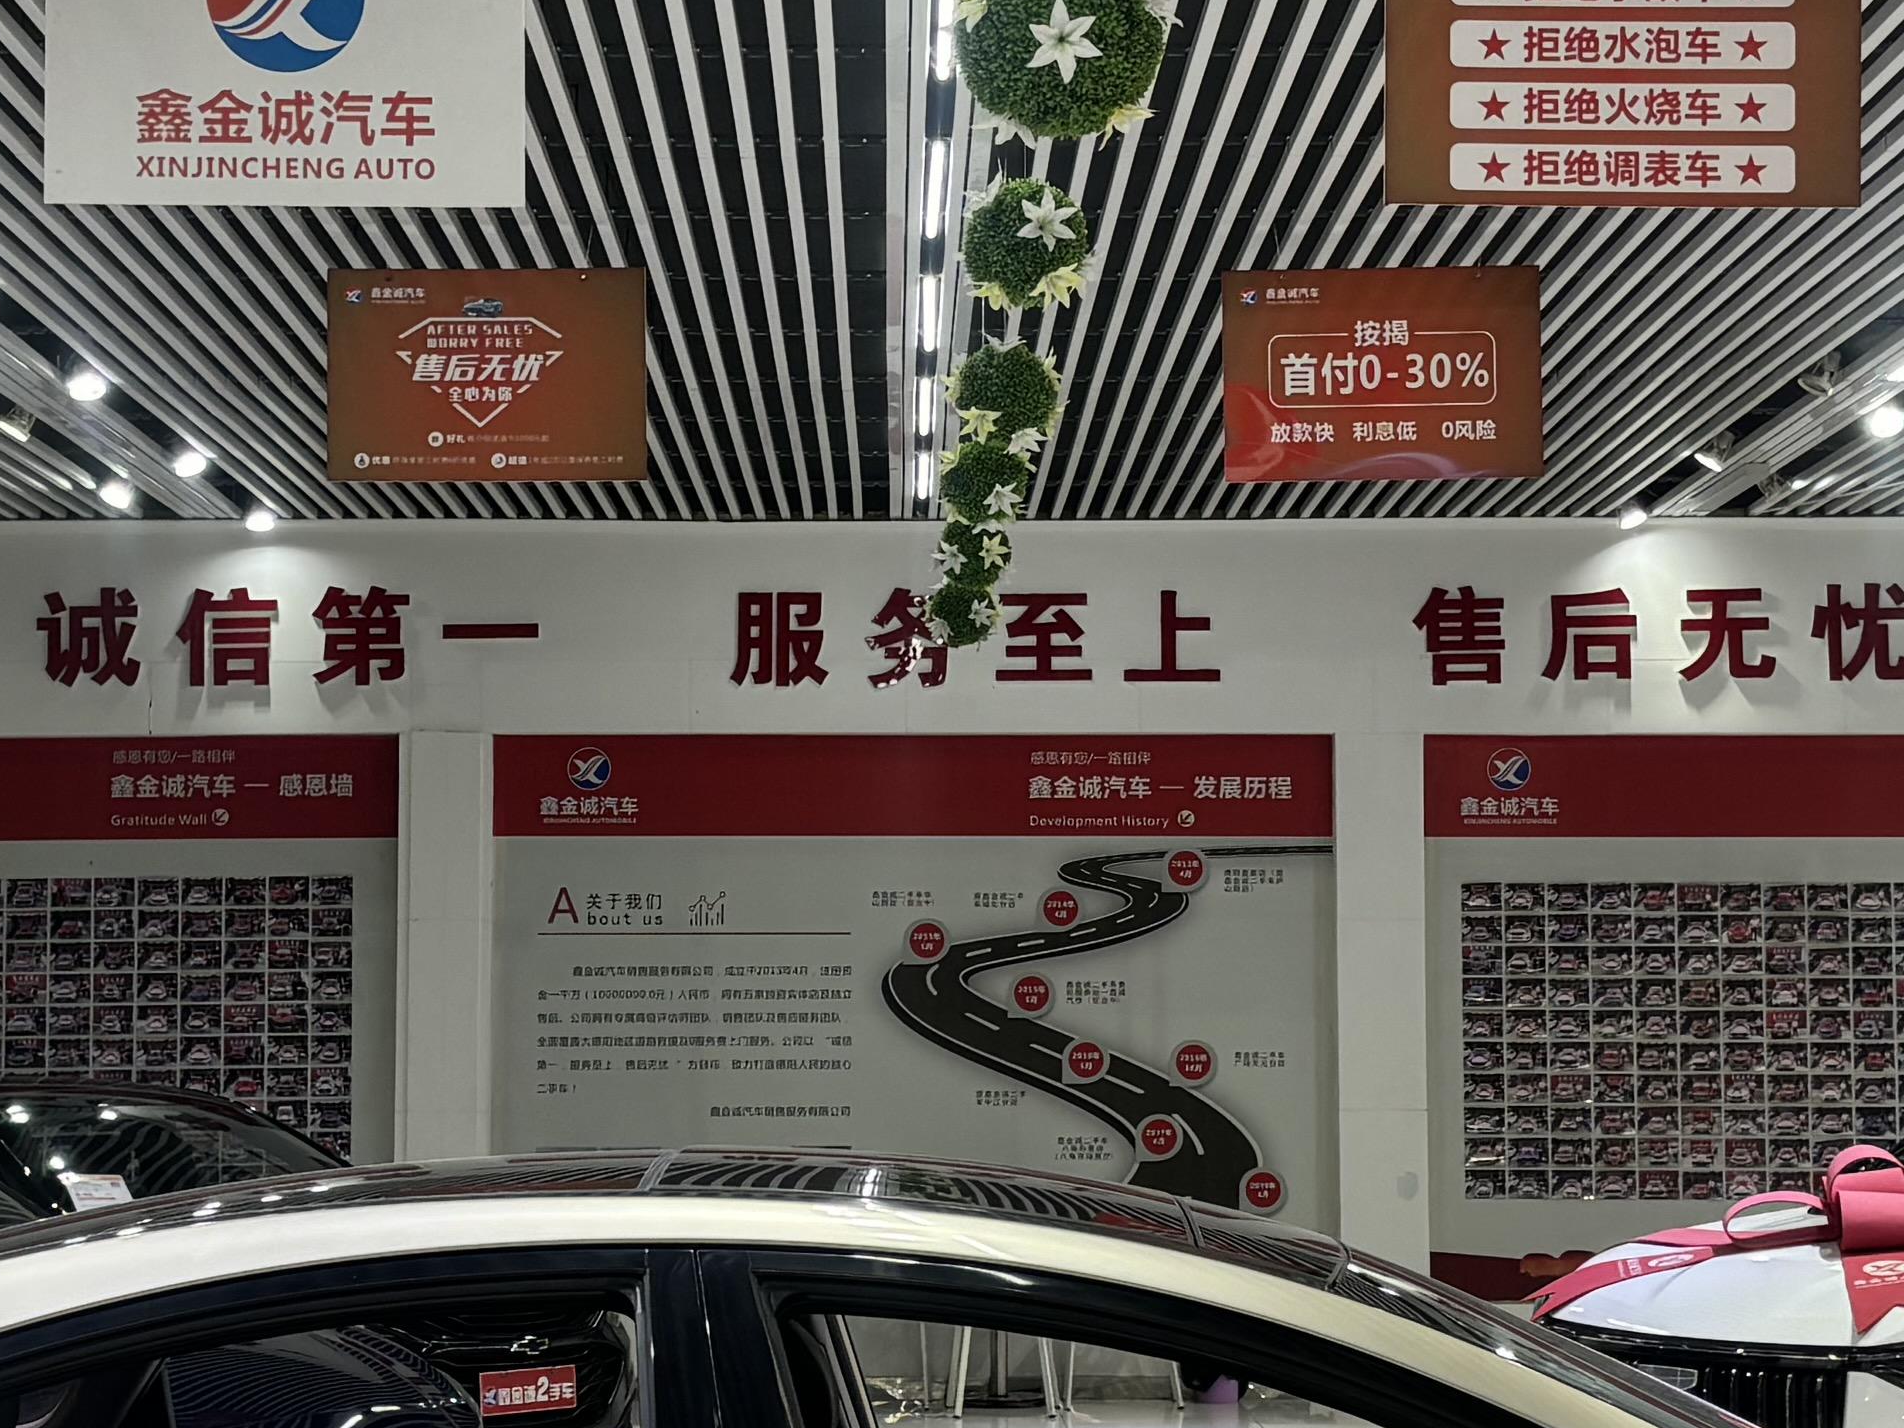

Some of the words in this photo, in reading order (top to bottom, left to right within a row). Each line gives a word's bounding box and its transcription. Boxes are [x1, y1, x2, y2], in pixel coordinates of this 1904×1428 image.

[1523, 26, 1722, 64] 拒绝水泡车
[136, 88, 435, 146] 鑫金诚汽车
[1523, 87, 1722, 126] 拒绝火烧车
[136, 155, 344, 180] XINJINCHENG
[354, 157, 435, 180] AUTO
[1523, 149, 1722, 187] 拒绝调表车
[427, 324, 476, 335] AFTER
[483, 324, 533, 335] SALES
[1353, 320, 1409, 346] 按揭
[485, 338, 524, 349] FREE
[412, 354, 544, 381] 售后无忧
[1279, 351, 1490, 396] 首付0-30%
[449, 387, 513, 402] 全心为你
[1271, 421, 1335, 443] 放款快
[1353, 420, 1417, 442] 利息低
[1441, 419, 1496, 441] 0风险
[37, 586, 539, 687] 诚信第一
[729, 587, 1222, 690] 服务至上
[110, 774, 236, 798] 鑫金诚汽车
[279, 774, 353, 798] 感恩墙
[1029, 775, 1151, 799] 鑫金诚汽车
[1193, 775, 1292, 799] 发展历程
[540, 796, 639, 815] 鑫金诚汽车
[1461, 796, 1559, 816] 鑫金诚汽车
[111, 813, 175, 826] Gratitude
[179, 813, 207, 826] Wall
[1029, 815, 1117, 829] Development
[1121, 815, 1169, 829] History
[586, 893, 662, 910] 关于我们
[643, 914, 663, 926] us
